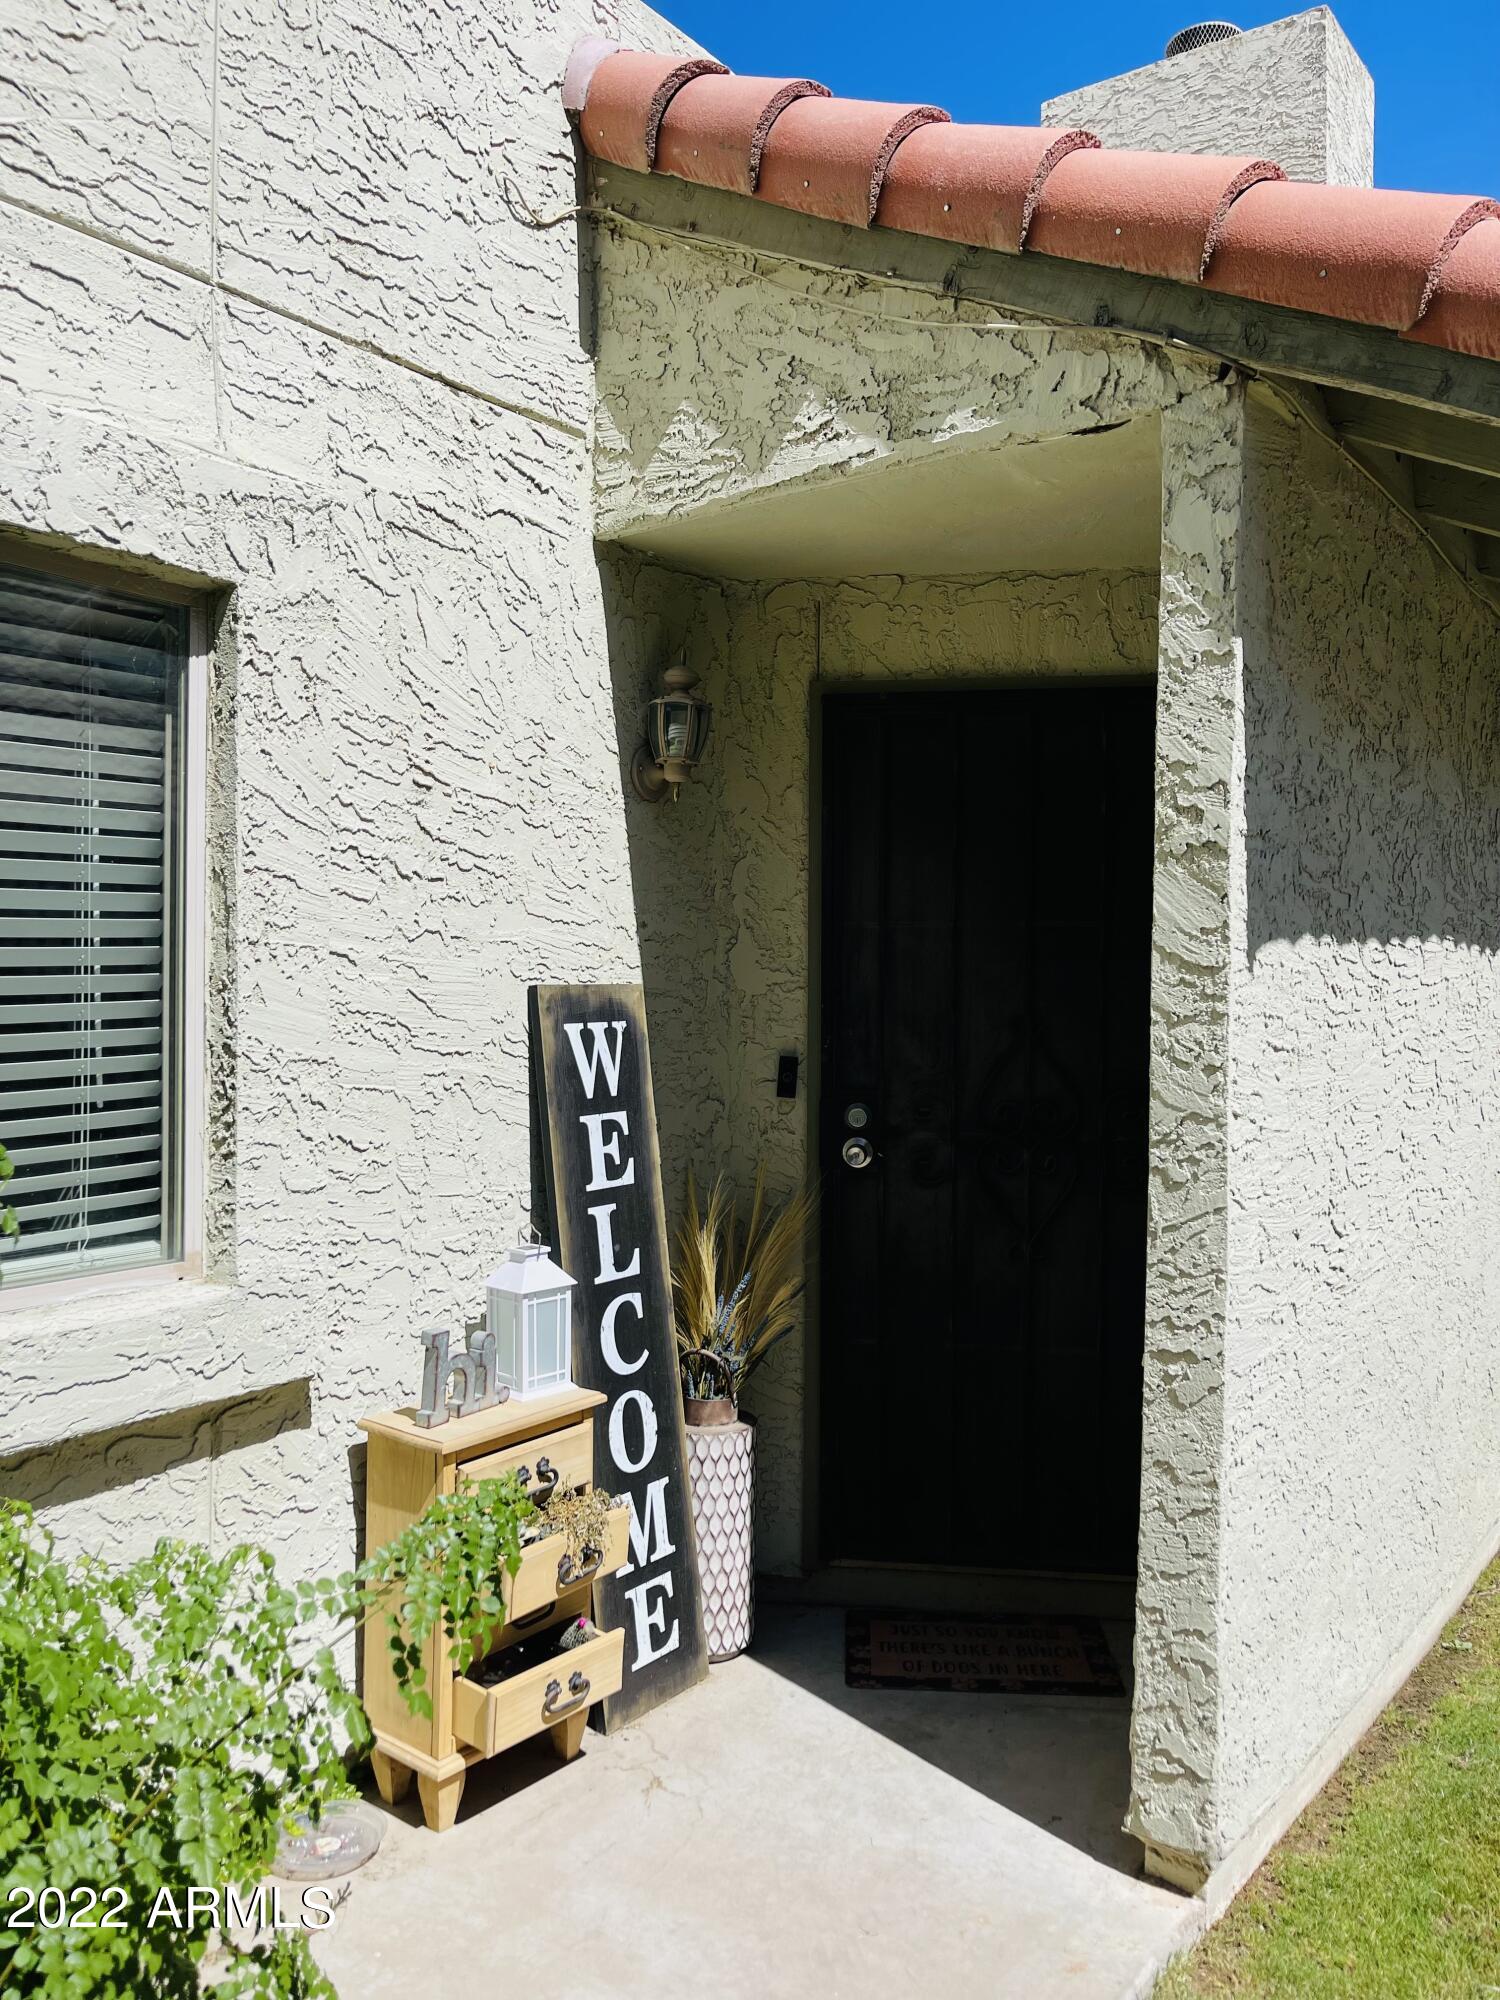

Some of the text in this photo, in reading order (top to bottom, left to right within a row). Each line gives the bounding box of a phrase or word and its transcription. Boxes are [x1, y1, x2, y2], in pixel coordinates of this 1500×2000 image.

[563, 1021, 680, 1672] WELCOME
[888, 1624, 929, 1637] JUST
[934, 1624, 957, 1638] SO
[878, 1641, 1079, 1659] THERE'S LIKE A BUNCH
[902, 1659, 1065, 1677] OF DOGS IN HERE
